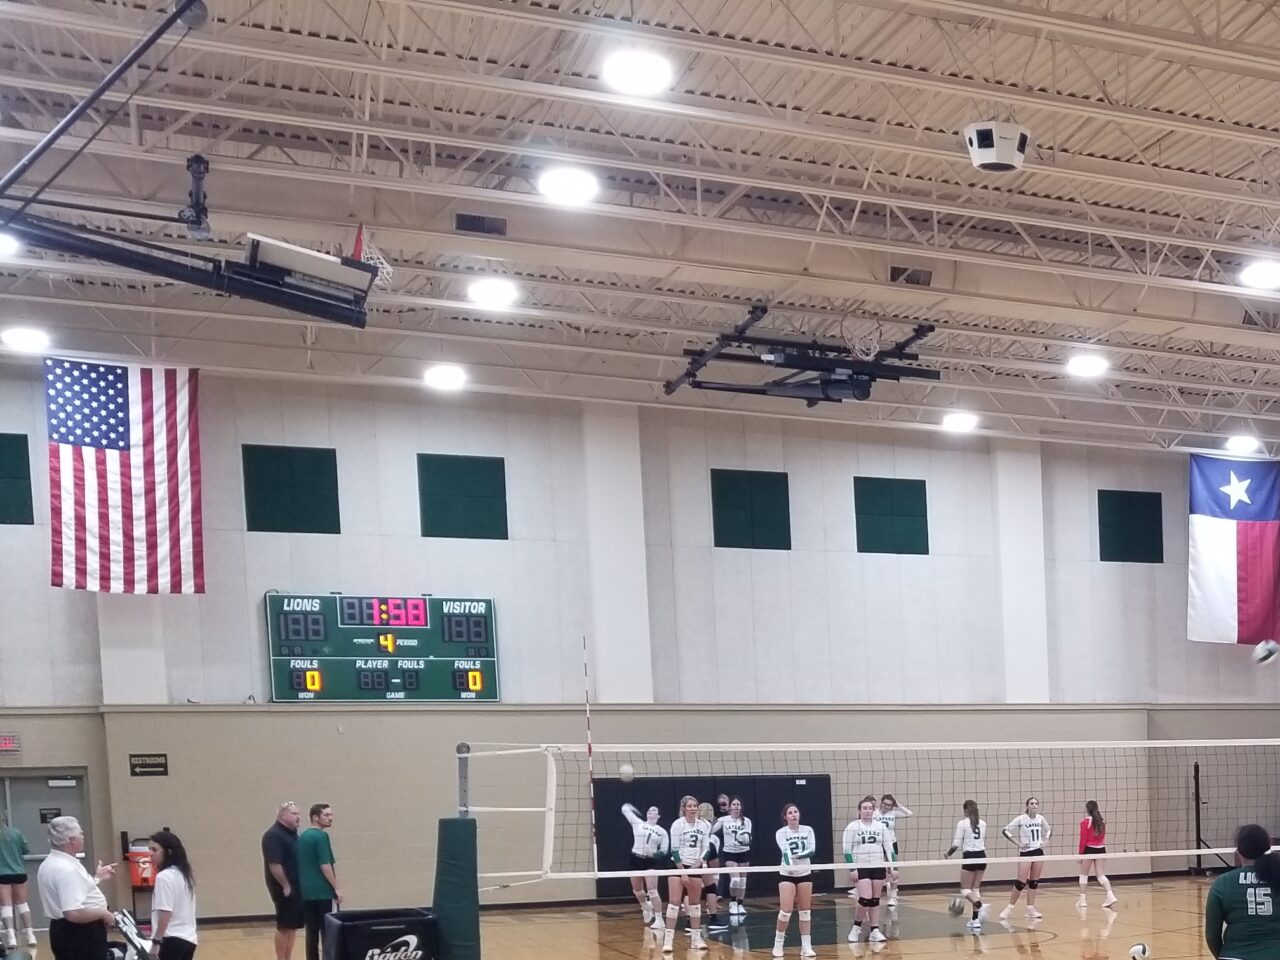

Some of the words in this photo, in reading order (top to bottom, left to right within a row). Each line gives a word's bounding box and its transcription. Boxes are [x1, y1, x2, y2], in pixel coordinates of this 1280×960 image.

[283, 598, 320, 611] LIONS
[443, 601, 486, 614] VISITOR
[379, 633, 395, 654] 4
[290, 660, 318, 669] FOULS
[356, 660, 388, 669] PLAYER
[398, 660, 425, 669] FOULS
[454, 661, 481, 669] FOULS
[305, 670, 321, 691] 0
[468, 671, 482, 690] 0
[689, 835, 699, 848] 3
[1031, 829, 1039, 841] 11
[789, 841, 806, 855] 21
[1246, 887, 1273, 915] 15
